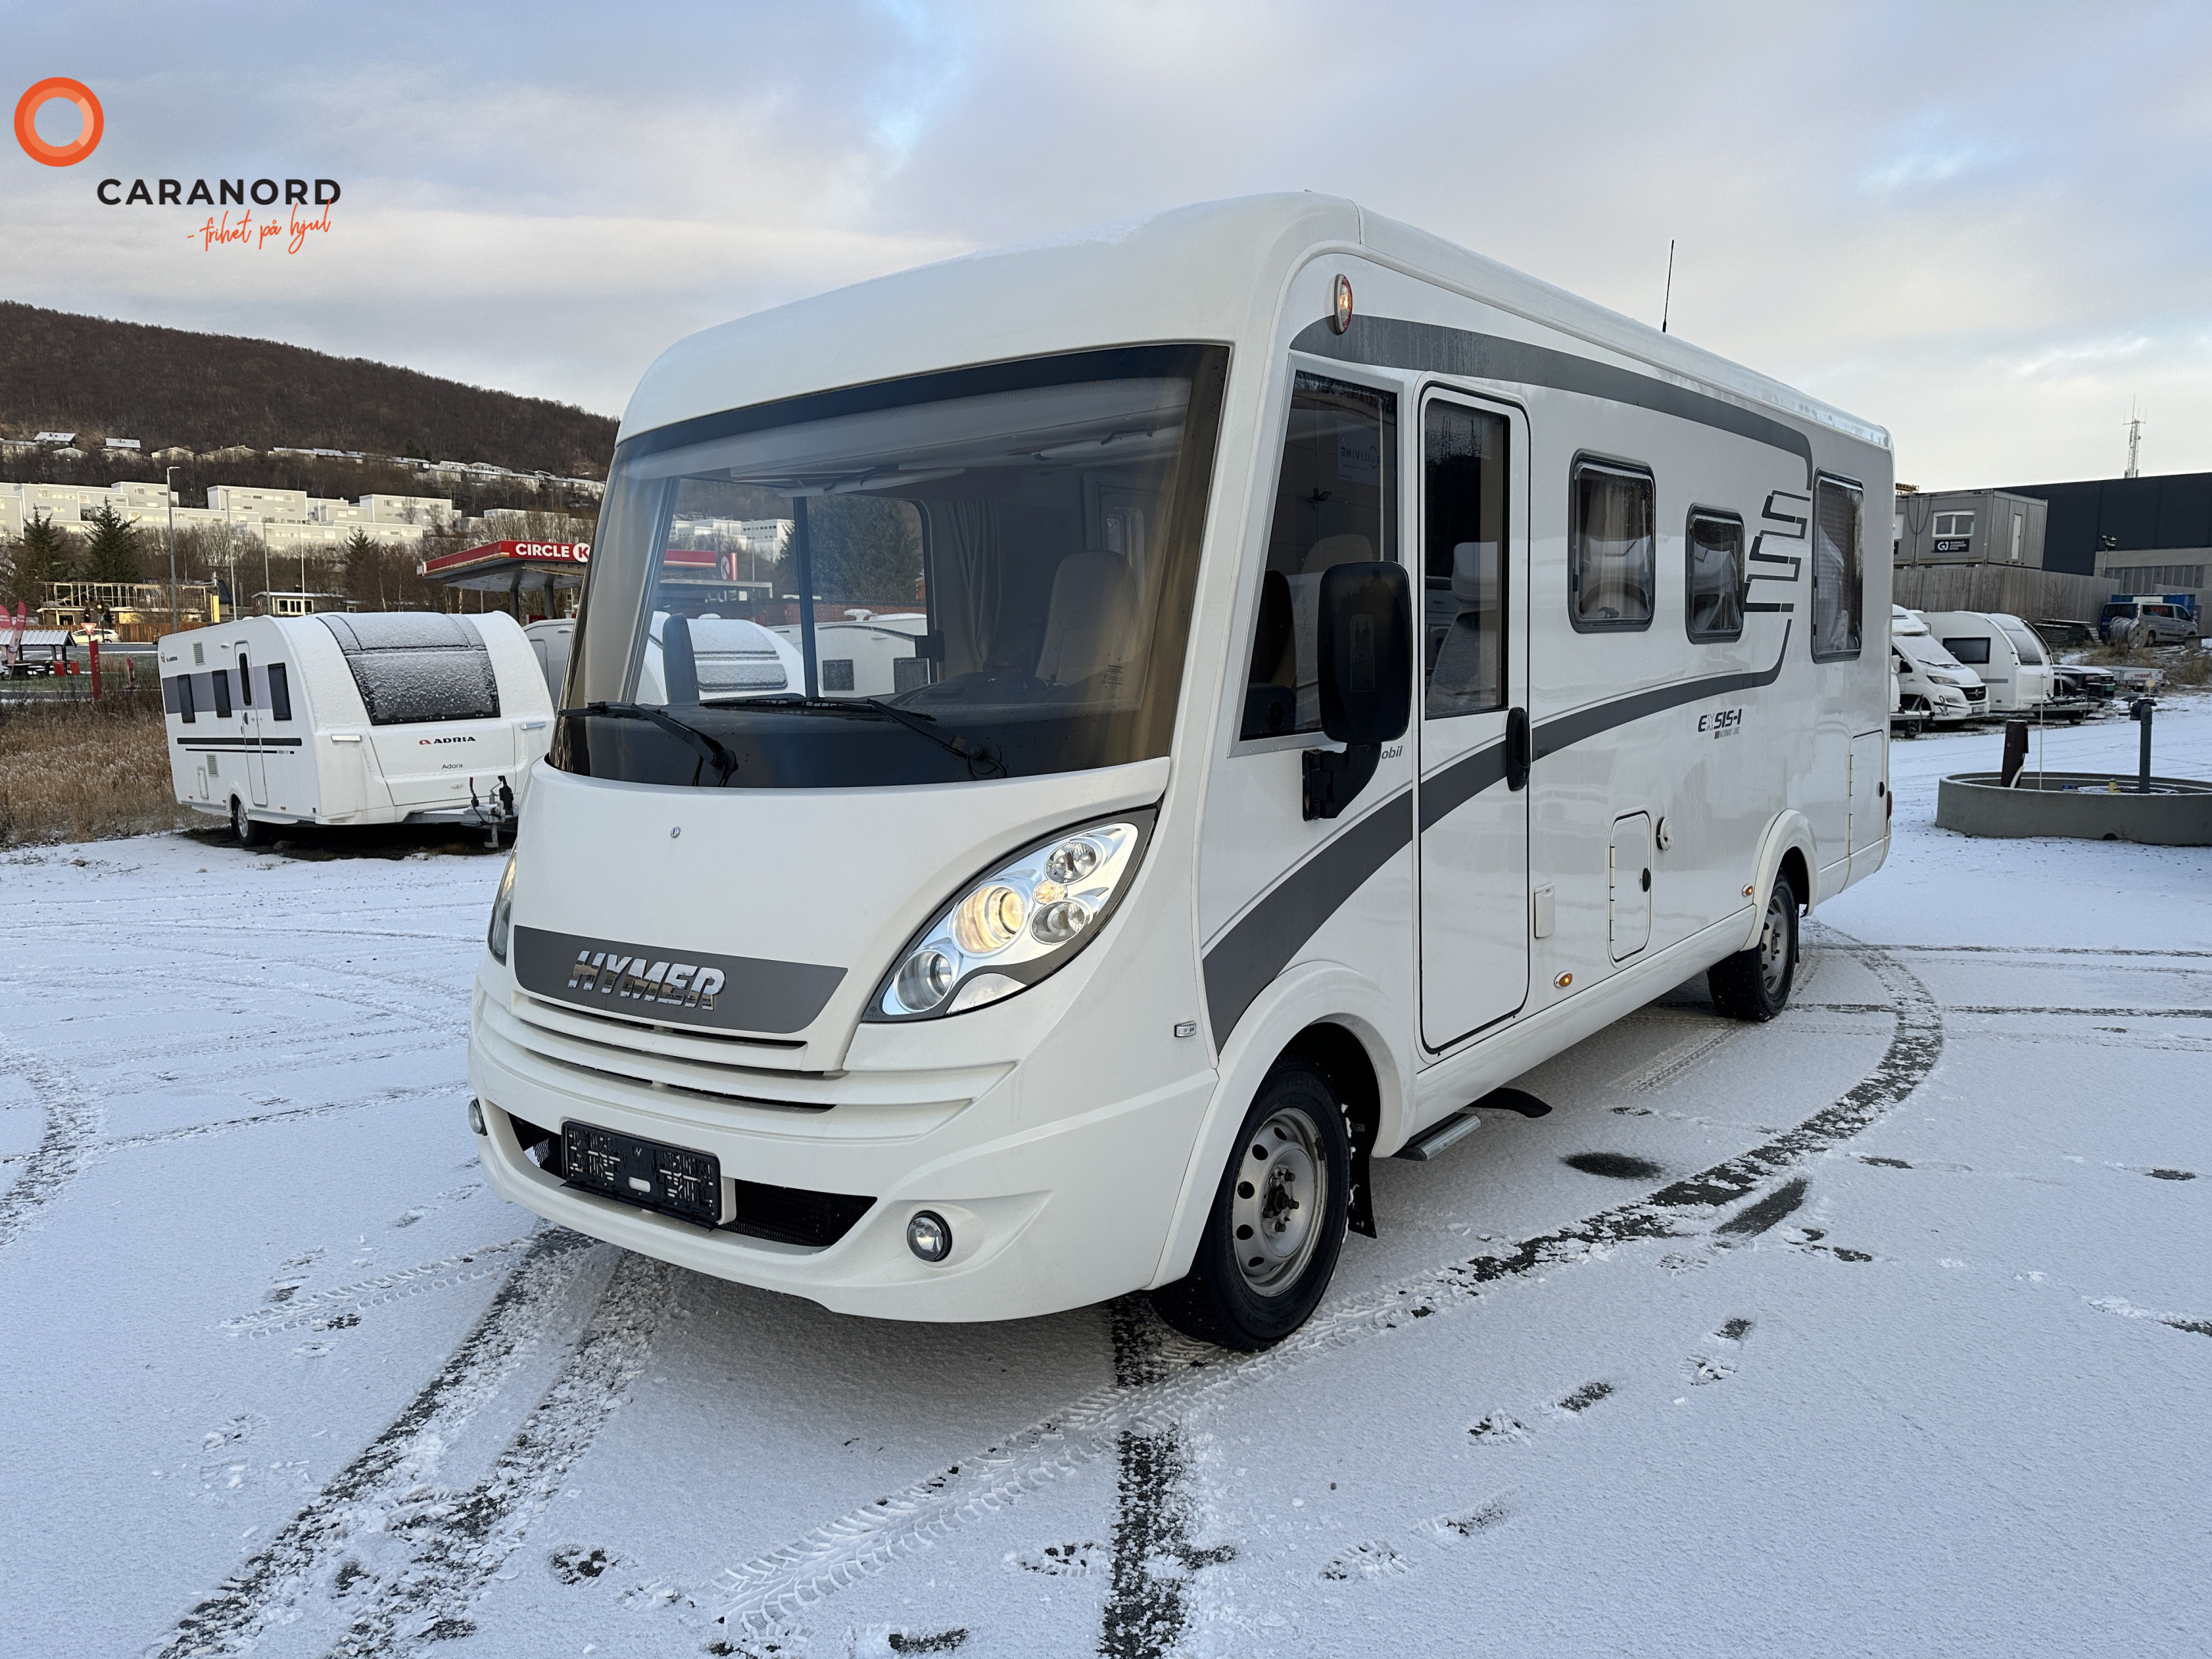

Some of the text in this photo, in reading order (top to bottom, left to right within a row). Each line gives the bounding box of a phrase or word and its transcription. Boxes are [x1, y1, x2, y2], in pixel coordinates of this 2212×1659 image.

[515, 543, 590, 559] CIRCLE K
[433, 736, 476, 744] ADRIA
[1381, 745, 1403, 760] obil
[568, 950, 727, 1011] HYMER
